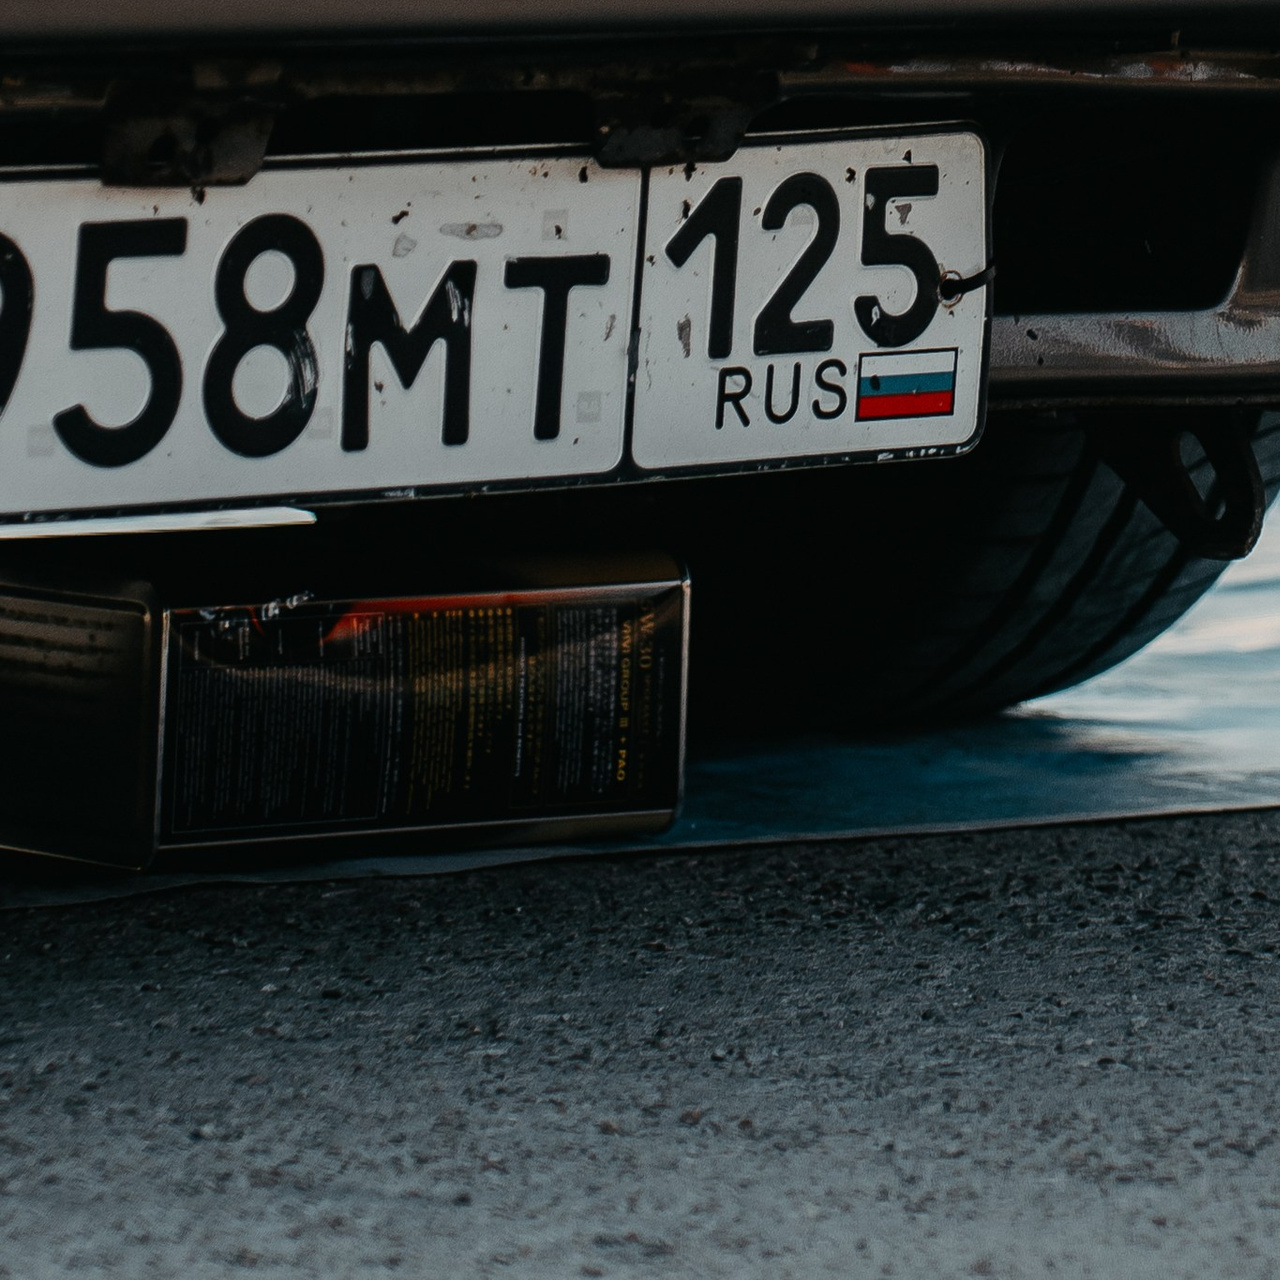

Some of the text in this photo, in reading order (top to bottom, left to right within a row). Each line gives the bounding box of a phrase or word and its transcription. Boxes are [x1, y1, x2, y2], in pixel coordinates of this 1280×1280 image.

[664, 164, 940, 360] 125
[715, 358, 848, 430] RUS
[619, 657, 631, 711] GROUP
